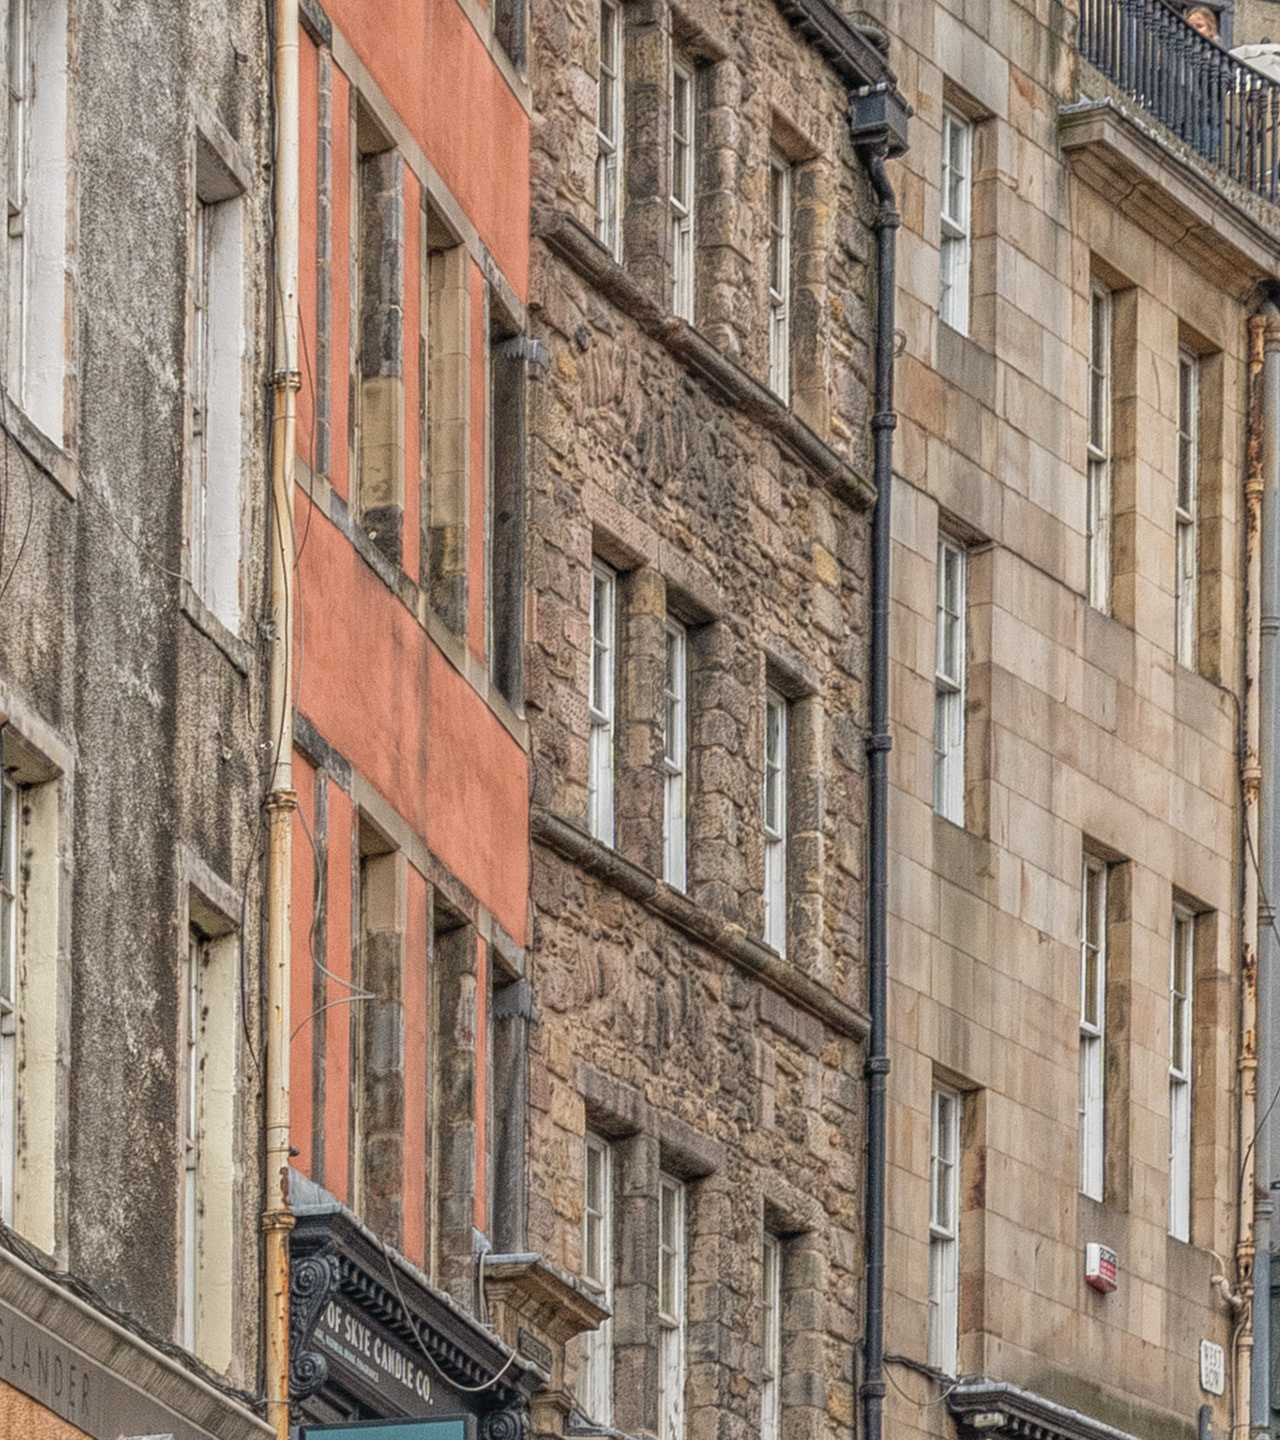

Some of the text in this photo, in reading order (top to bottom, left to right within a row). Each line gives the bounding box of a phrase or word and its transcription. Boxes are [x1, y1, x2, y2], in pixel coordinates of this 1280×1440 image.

[327, 1300, 342, 1333] OF
[344, 1313, 371, 1358] SKYE
[373, 1336, 414, 1390] CANDLE
[416, 1369, 434, 1406] CO.
